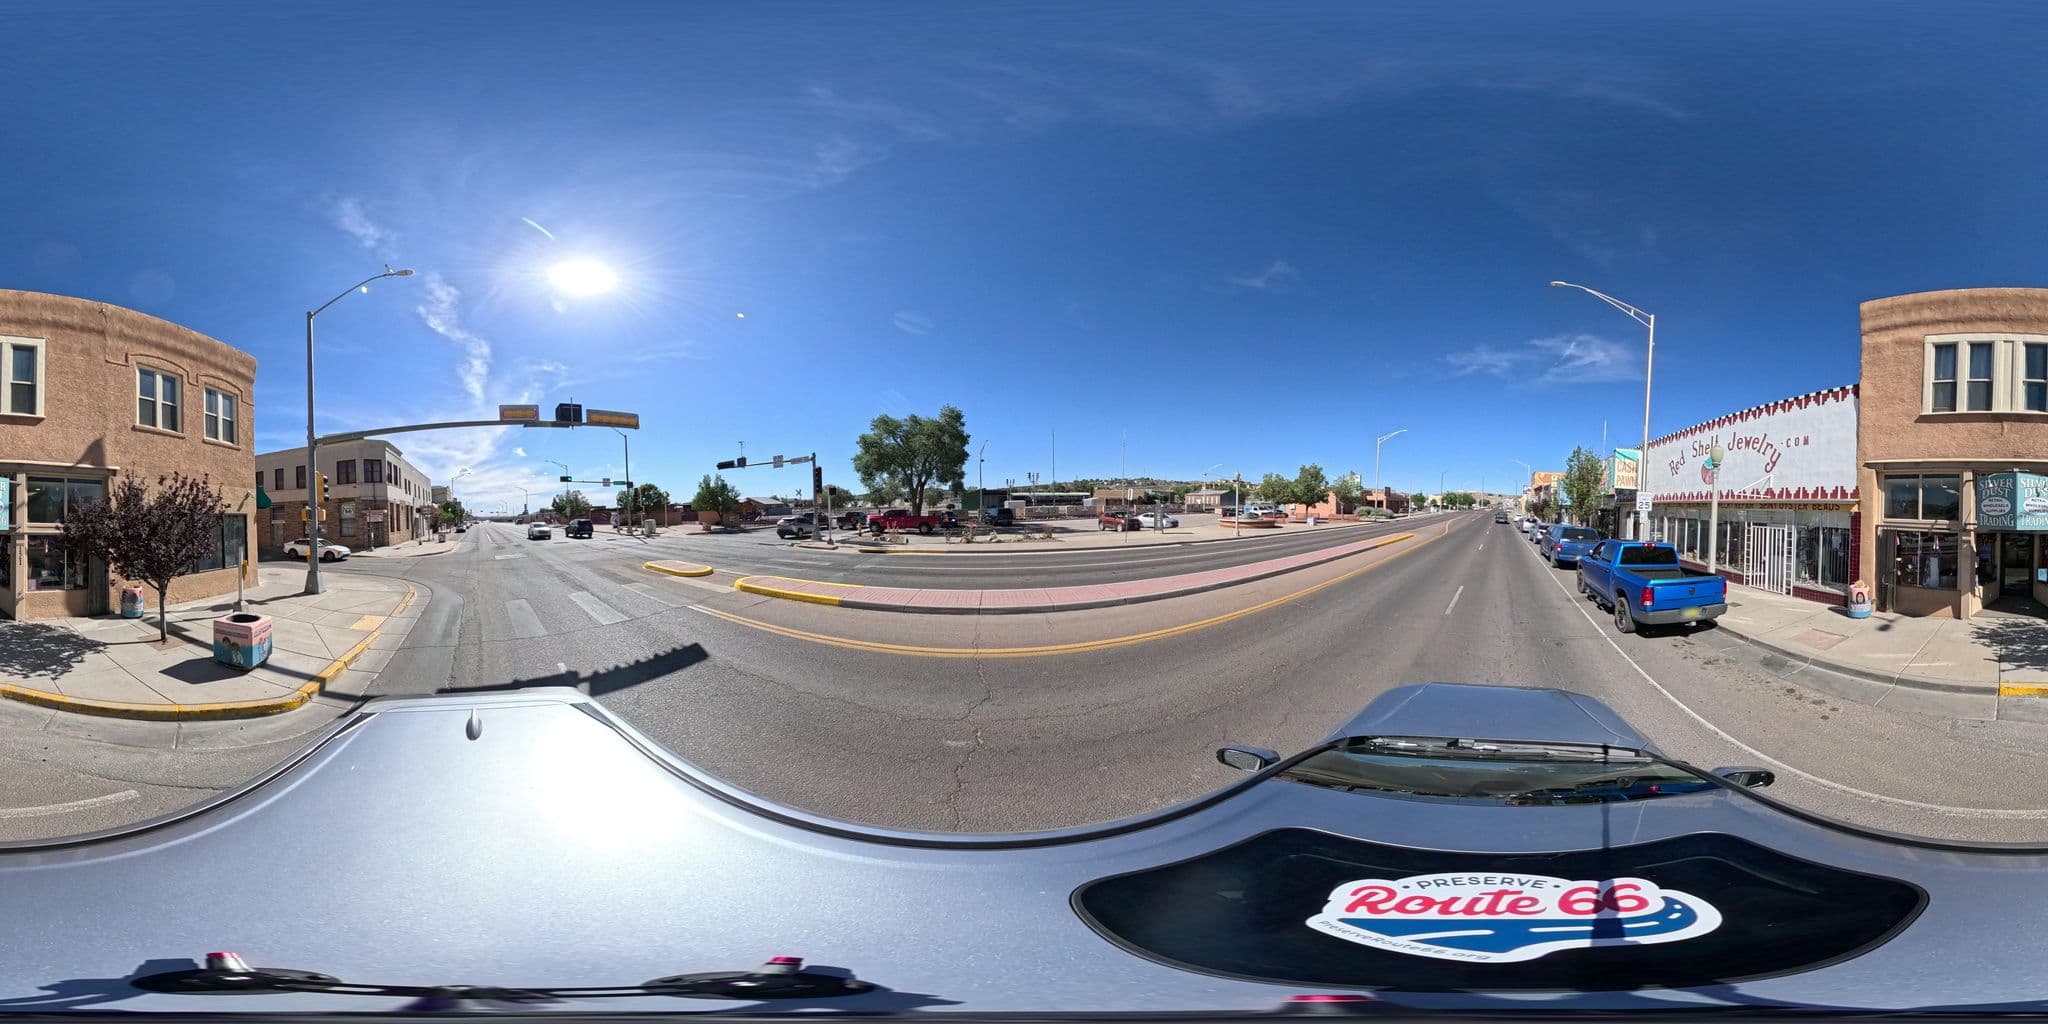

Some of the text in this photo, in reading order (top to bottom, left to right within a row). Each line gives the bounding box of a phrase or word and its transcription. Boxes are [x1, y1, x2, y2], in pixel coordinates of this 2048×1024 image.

[1668, 450, 1686, 477] Red
[1727, 431, 1782, 474] Jewelry
[1979, 478, 2014, 490] SILVER
[1982, 487, 2010, 499] DUST
[1638, 501, 1650, 510] 25
[1979, 513, 2014, 527] TRADING
[1416, 876, 1548, 890] PRESERVE
[1344, 883, 1650, 916] Route 66
